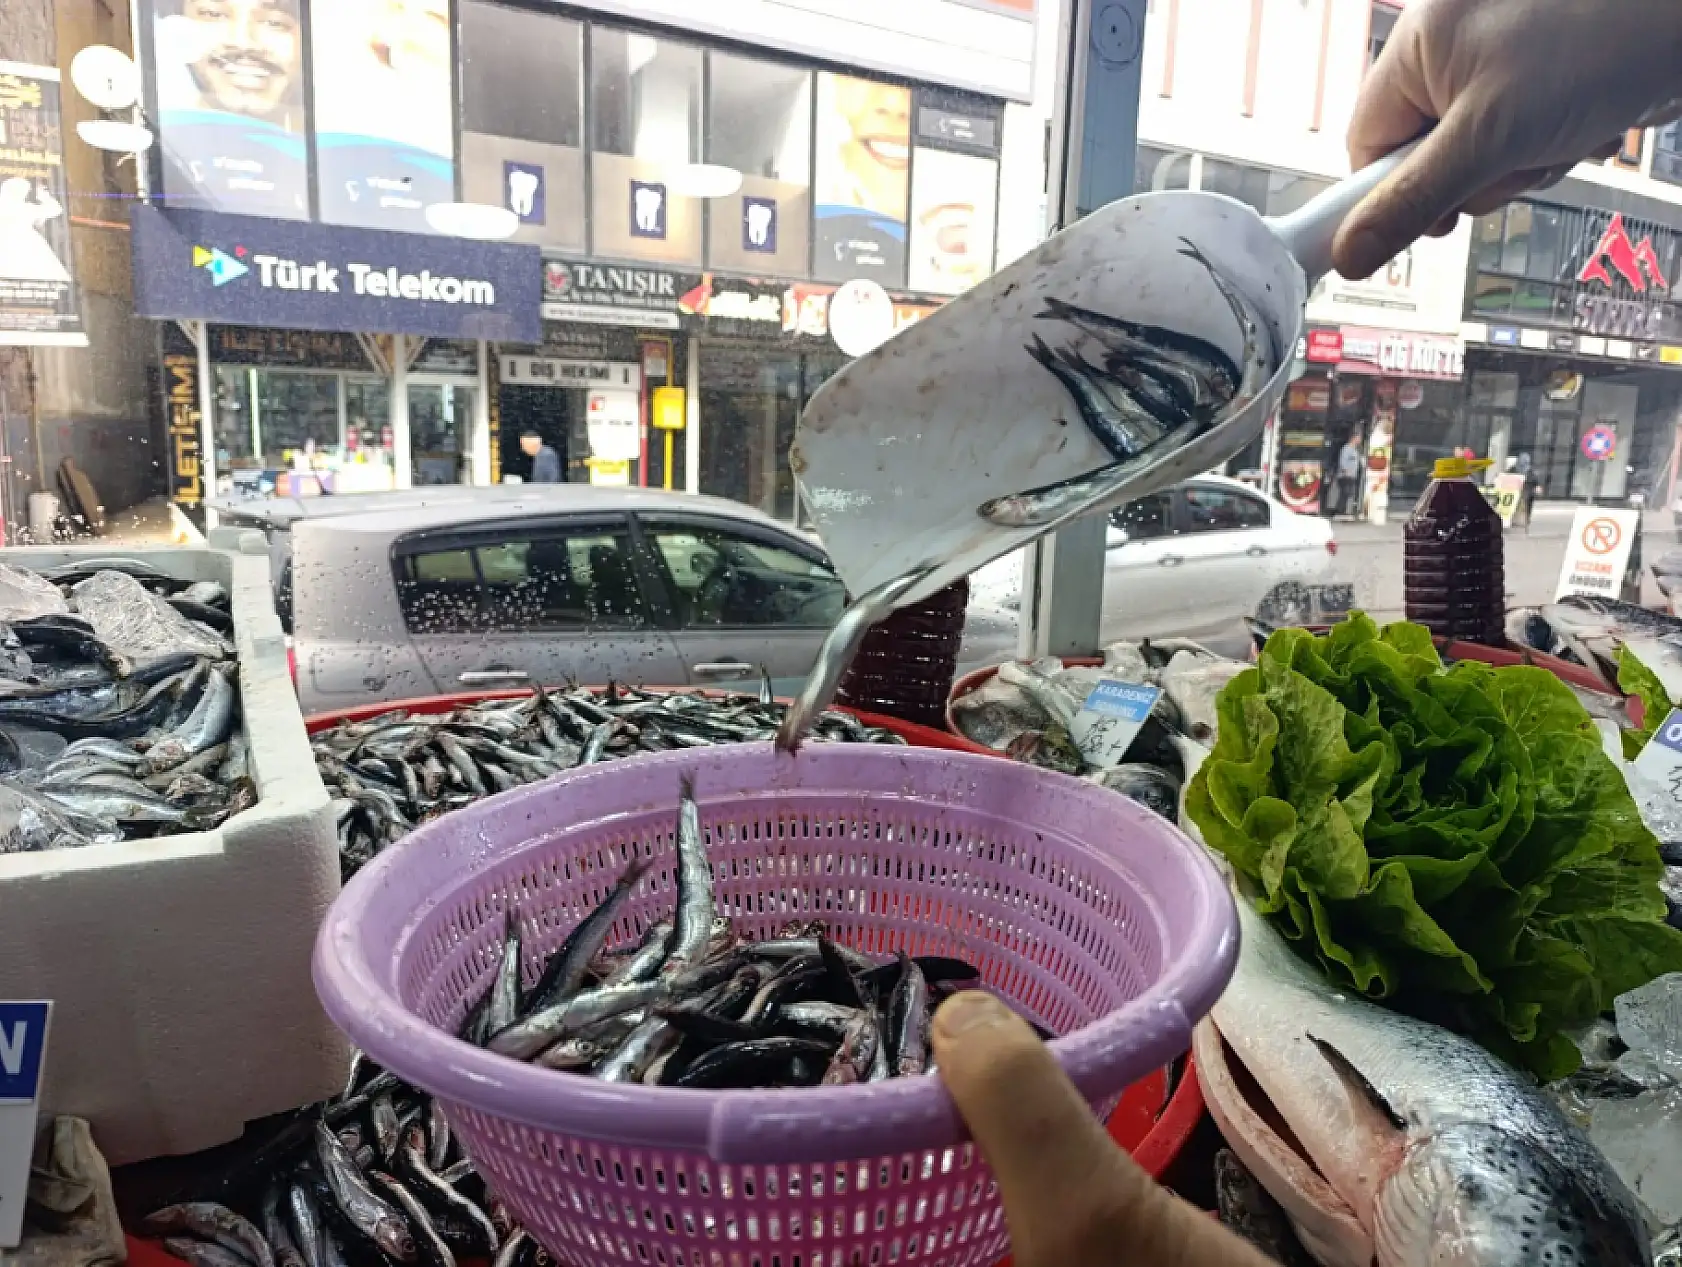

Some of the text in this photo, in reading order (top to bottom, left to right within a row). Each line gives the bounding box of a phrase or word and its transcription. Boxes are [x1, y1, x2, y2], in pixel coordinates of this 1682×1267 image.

[253, 254, 340, 293] Türk
[347, 262, 495, 305] Telekom
[572, 264, 676, 297] TANIŞIR
